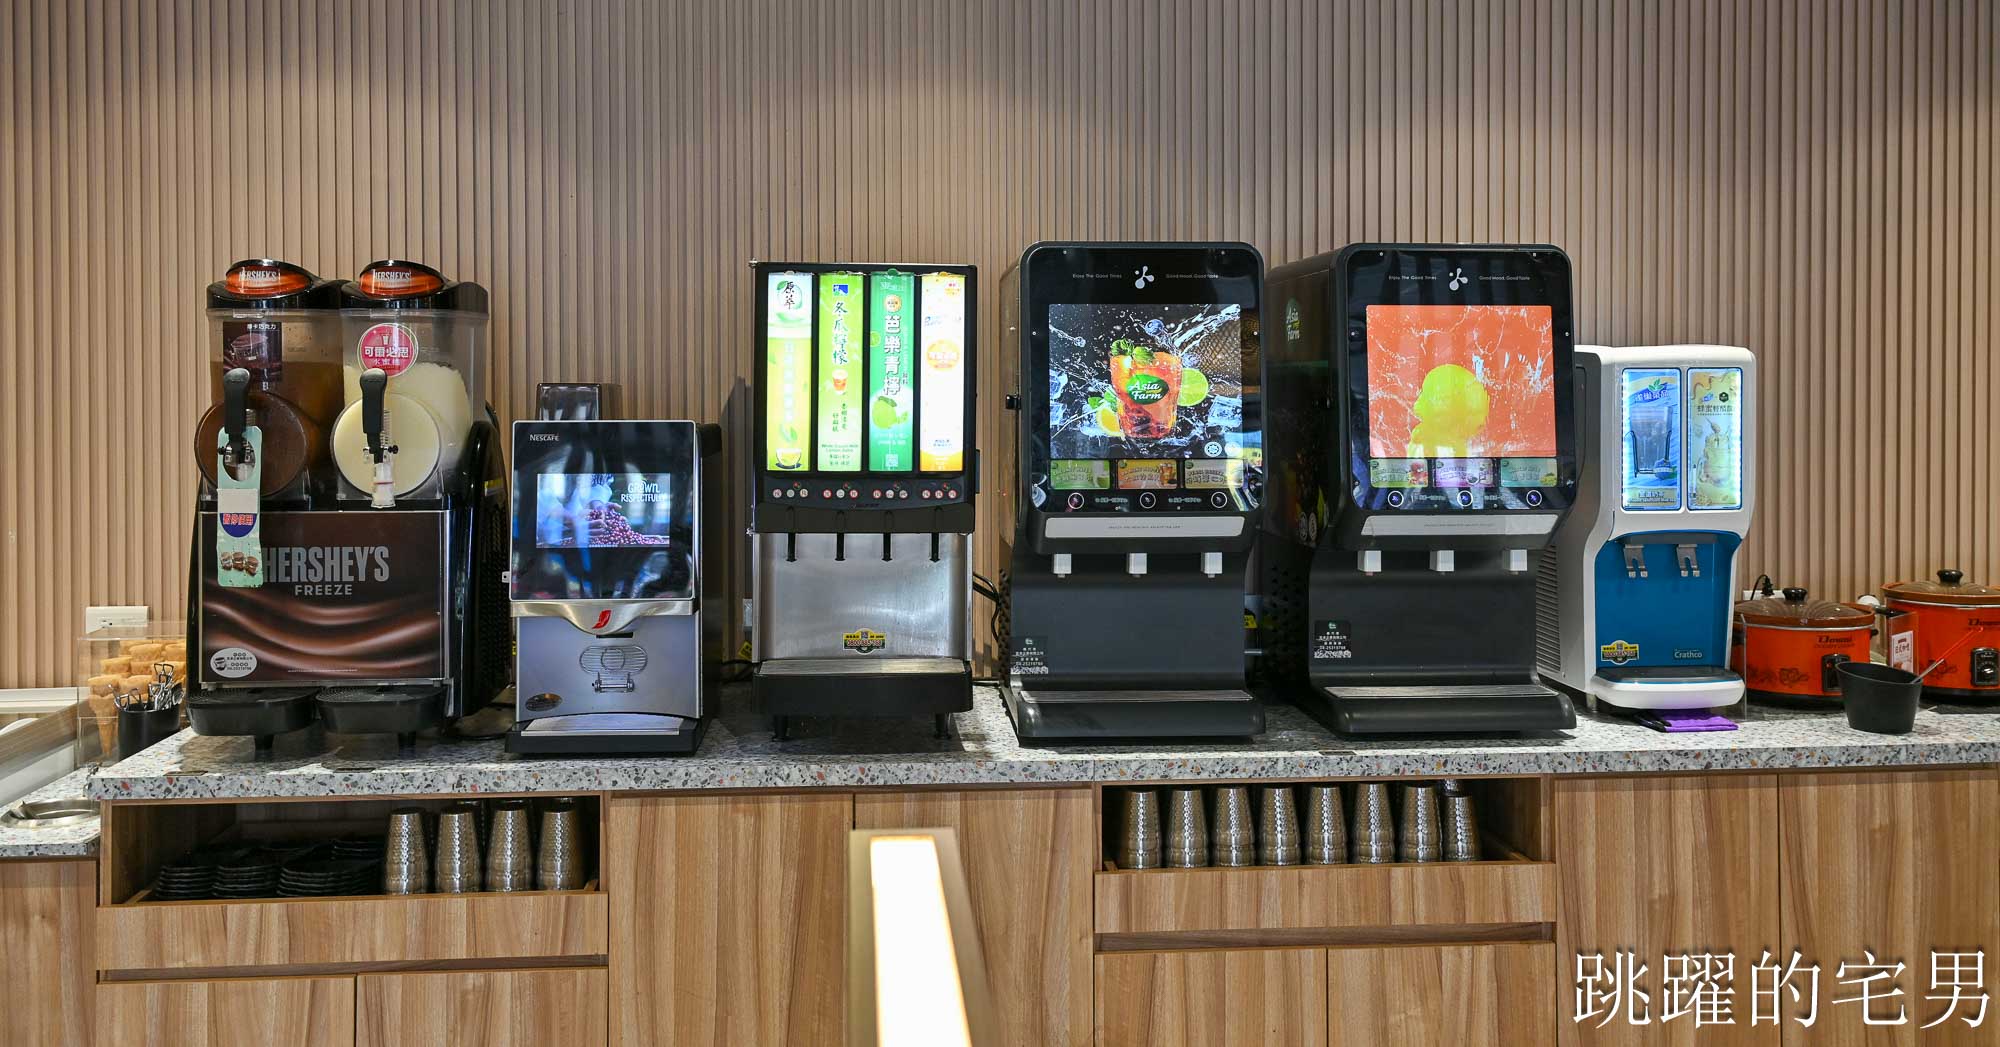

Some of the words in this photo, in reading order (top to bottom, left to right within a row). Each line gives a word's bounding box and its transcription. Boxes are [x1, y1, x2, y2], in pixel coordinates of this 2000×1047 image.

[783, 280, 796, 310] 原萃
[364, 346, 409, 358] 可爾必思
[883, 315, 902, 396] 芭樂青檸
[1128, 381, 1160, 391] Asia
[1131, 390, 1162, 400] Farm
[263, 546, 390, 583] HERSHEY'S
[294, 584, 353, 596] FREEZE
[1674, 649, 1703, 659] Crathco
